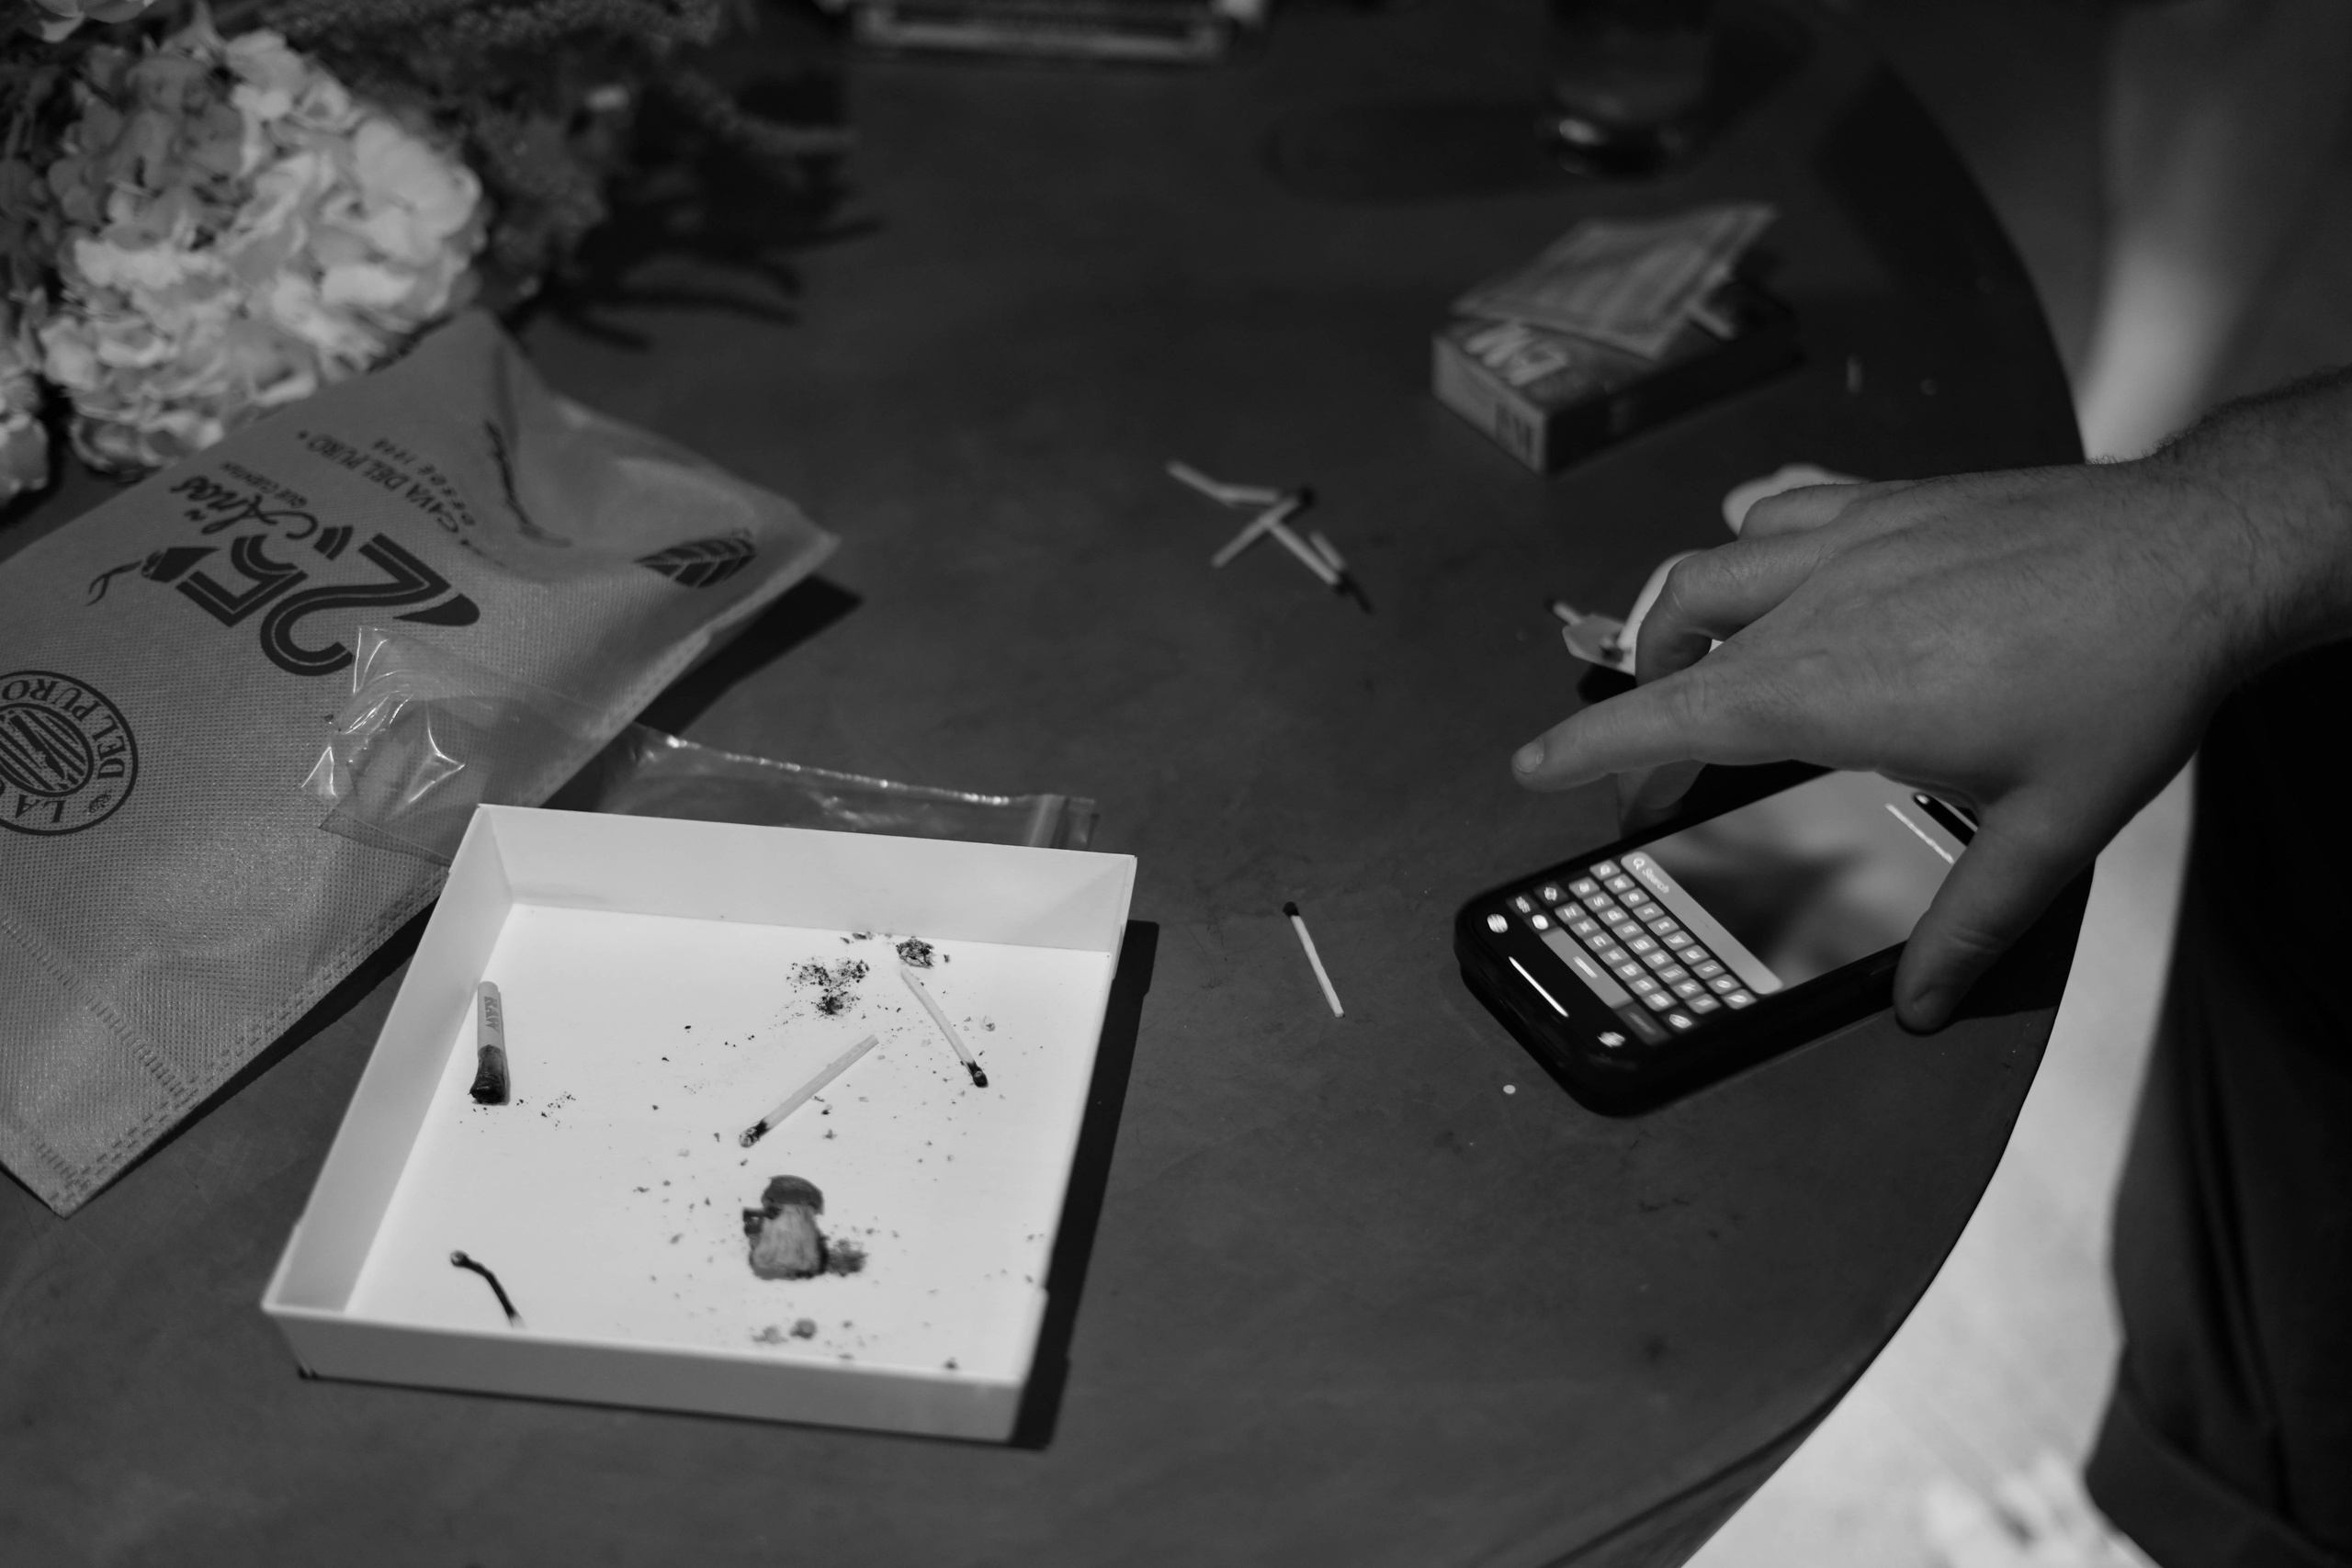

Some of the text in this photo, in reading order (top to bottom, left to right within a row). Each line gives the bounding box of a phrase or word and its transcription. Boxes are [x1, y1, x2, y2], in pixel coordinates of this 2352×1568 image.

[306, 434, 370, 470] PURO
[362, 461, 411, 491] DEL
[175, 533, 453, 677] 25
[2, 678, 127, 823] LA DEL PURO
[483, 996, 501, 1034] RAW
